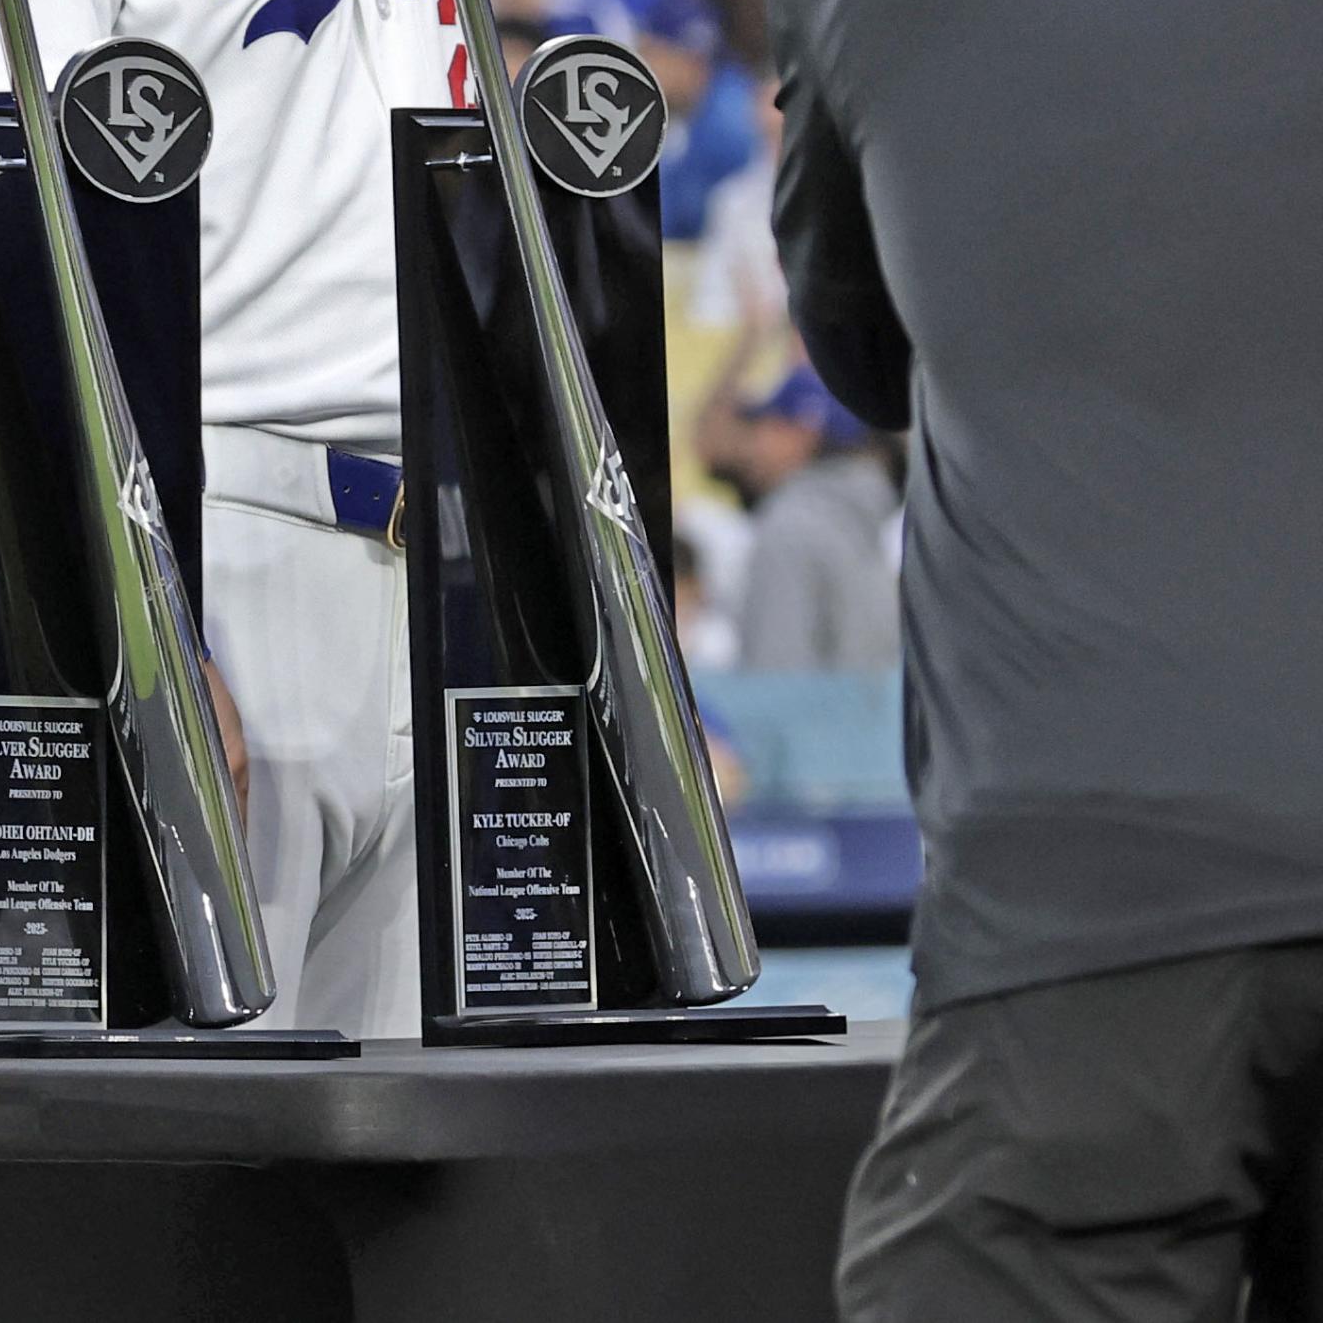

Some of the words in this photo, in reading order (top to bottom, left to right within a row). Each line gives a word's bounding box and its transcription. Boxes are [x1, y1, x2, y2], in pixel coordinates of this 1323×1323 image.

[483, 711, 526, 723] LOUISVILLE
[0, 720, 43, 732] LOUISVILLE
[464, 727, 512, 747] SILVER
[495, 748, 545, 769] AWARD
[9, 758, 62, 780] AWARD
[494, 778, 537, 788] PRESENTED
[537, 778, 547, 787] TO
[8, 788, 52, 799] PRESENTED
[473, 813, 504, 829] KYLE
[505, 812, 571, 828] TUCKER-OF
[26, 825, 95, 842] OHTANI-DH
[496, 835, 528, 849] Chicago
[529, 834, 550, 846] Cubs
[11, 847, 42, 863] Angeles
[43, 847, 77, 864] Dodgers
[496, 867, 526, 879] Member
[527, 867, 537, 878] Of
[537, 866, 552, 878] The
[7, 880, 38, 893] Member
[39, 881, 49, 893] Of
[49, 881, 65, 893] The
[469, 885, 499, 897] National
[500, 884, 525, 899] League
[526, 883, 560, 896] Offensive
[560, 882, 581, 895] Team
[10, 897, 37, 912] League
[38, 898, 72, 911] Offensive
[73, 899, 94, 911] Team
